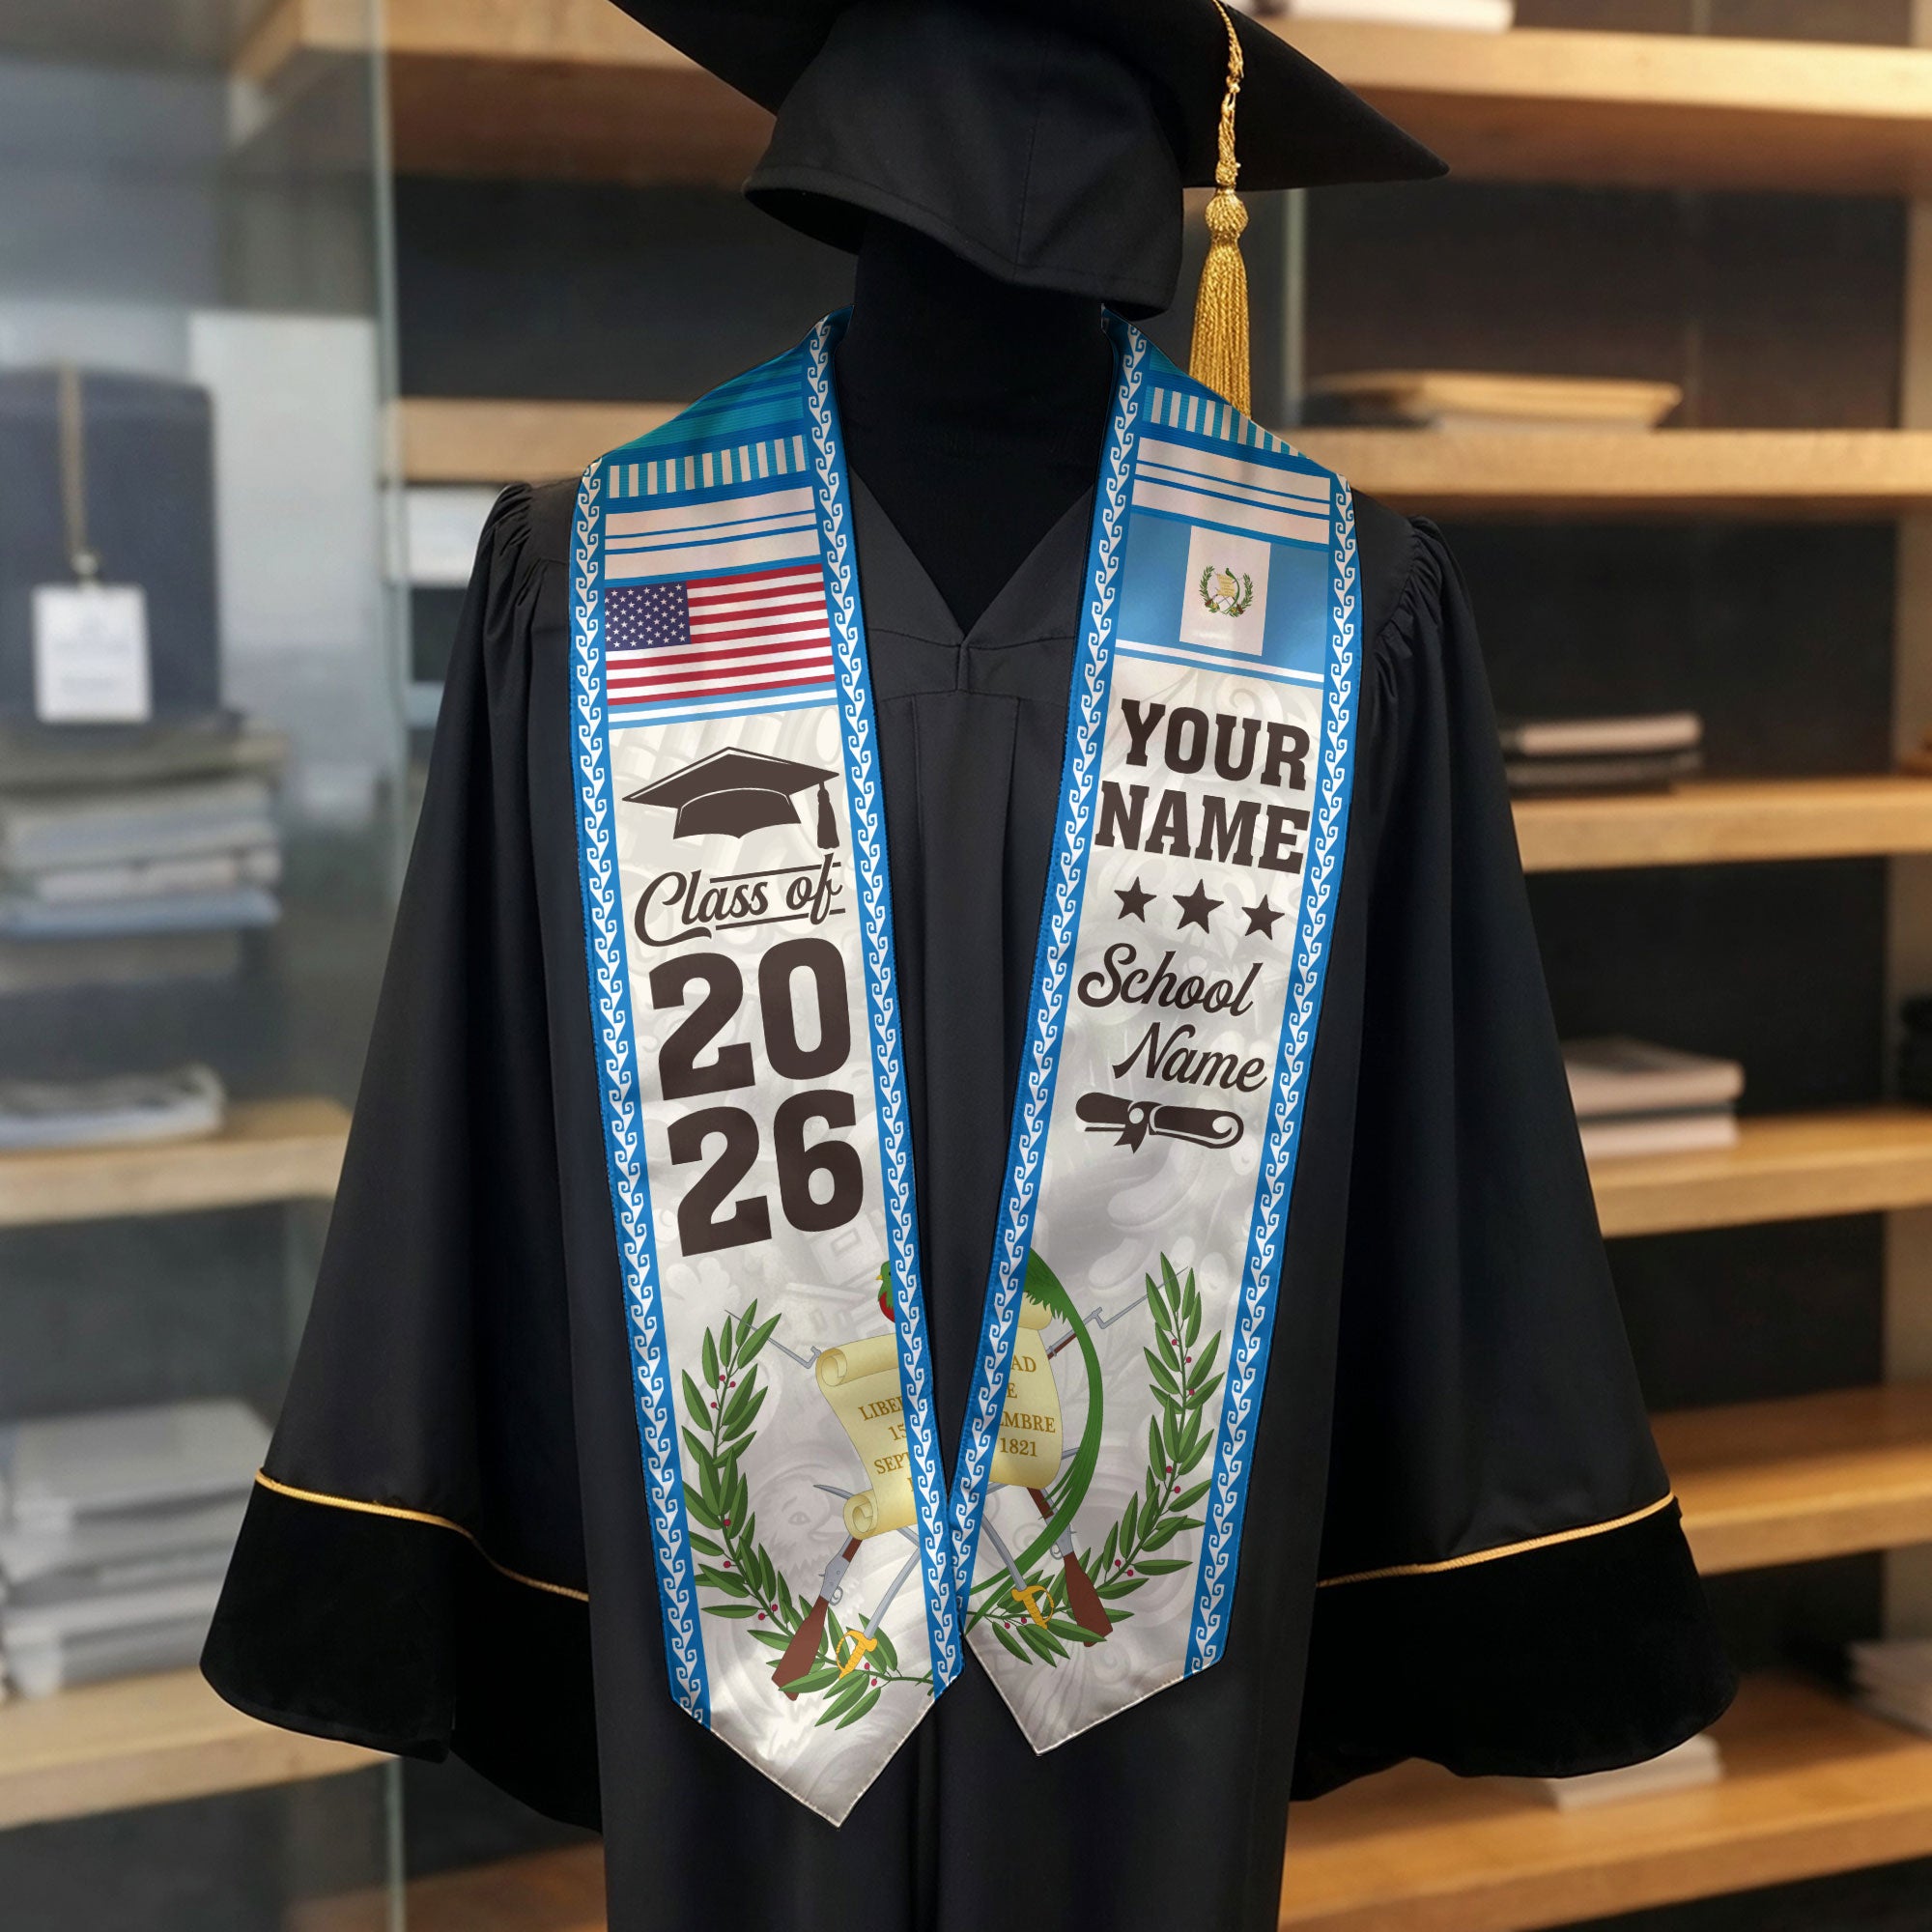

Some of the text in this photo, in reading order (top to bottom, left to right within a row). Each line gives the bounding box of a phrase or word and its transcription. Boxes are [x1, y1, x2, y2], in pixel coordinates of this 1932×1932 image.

[1121, 697, 1310, 791] YOUR
[1094, 780, 1311, 875] NAME
[634, 852, 843, 948] Class of
[648, 937, 851, 1101] 20
[1077, 942, 1264, 1017] School
[1112, 1021, 1268, 1093] Name
[667, 1089, 864, 1258] 26
[1000, 1410, 1056, 1433] MBRE
[1000, 1437, 1038, 1457] 1821
